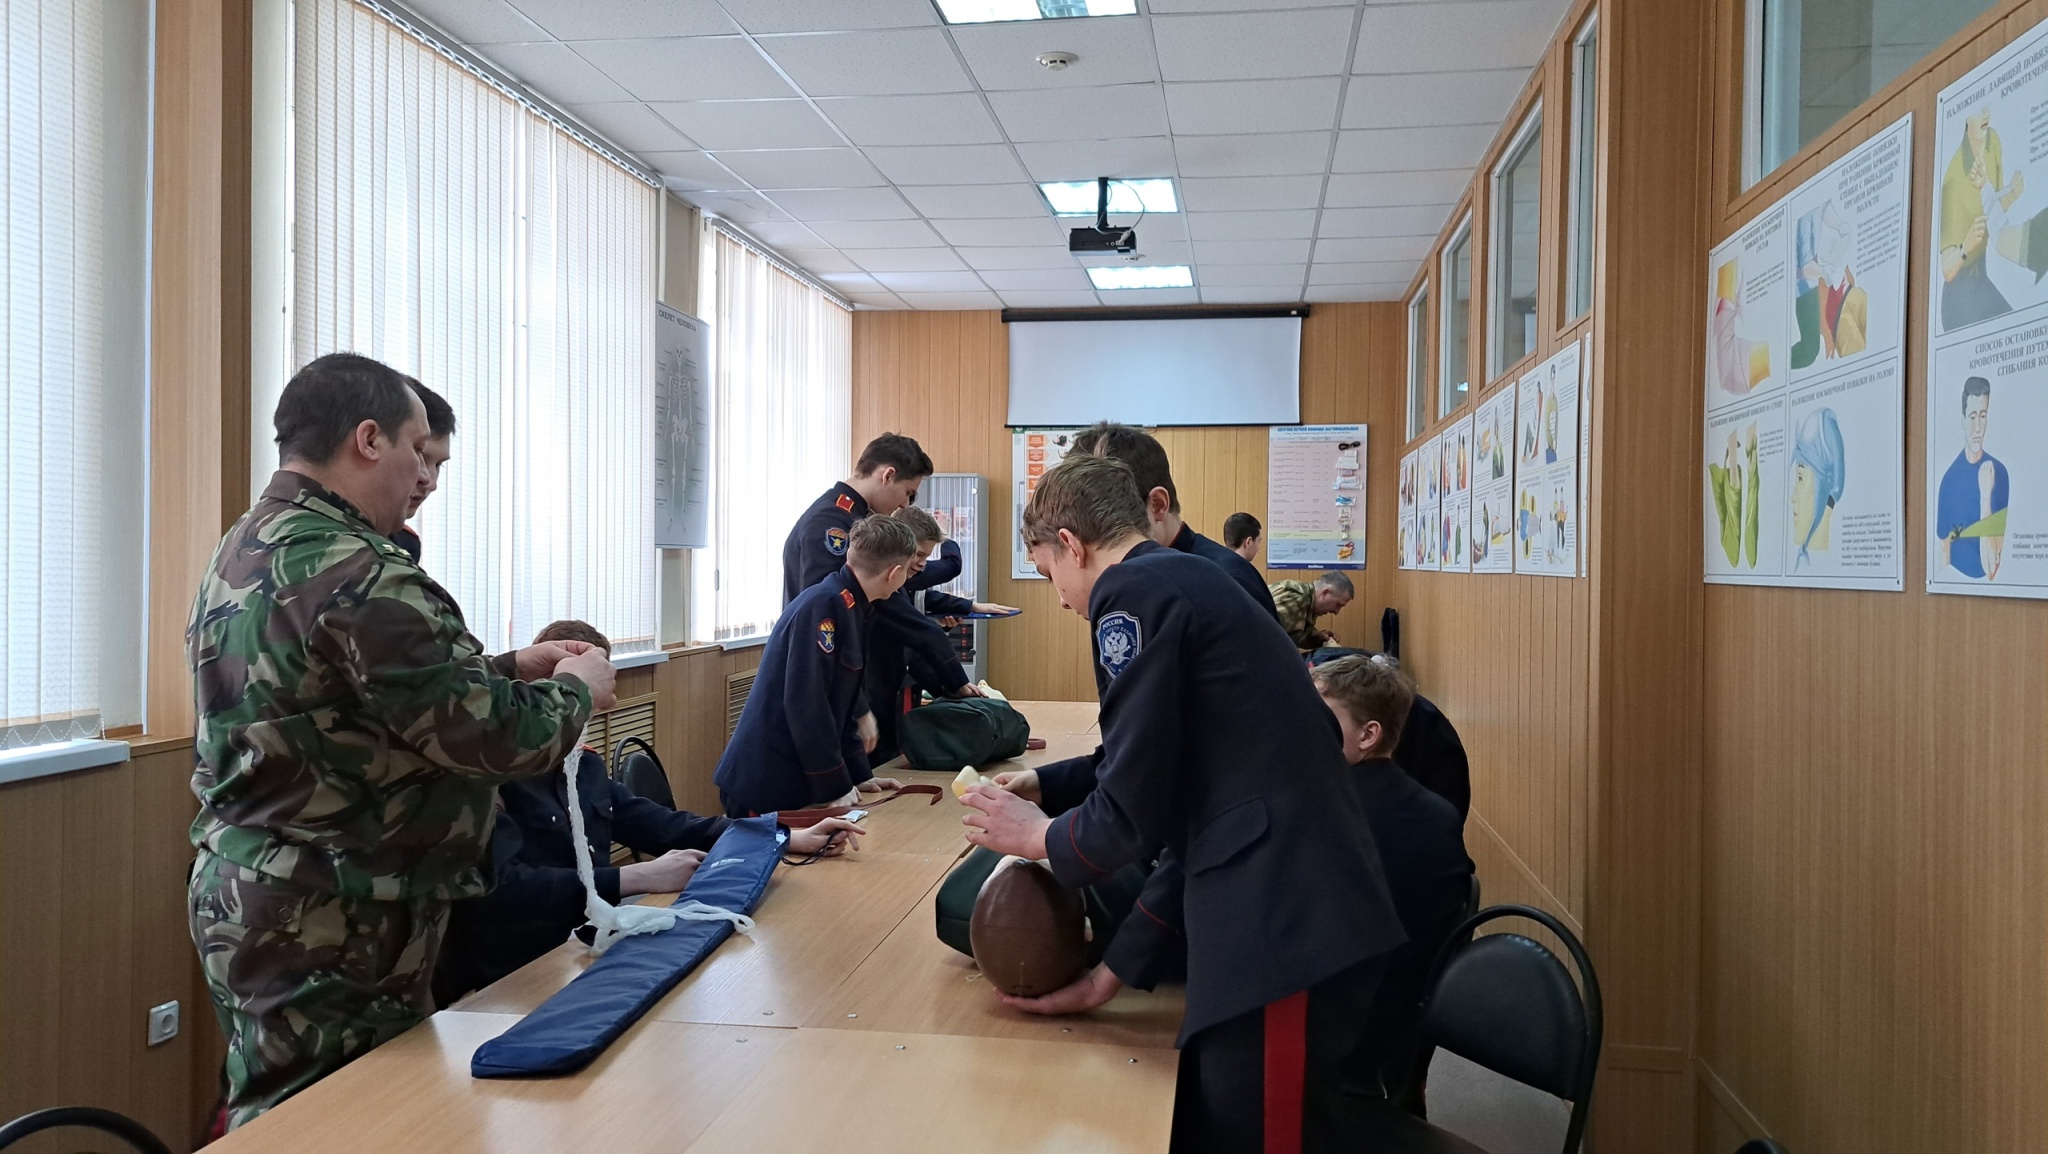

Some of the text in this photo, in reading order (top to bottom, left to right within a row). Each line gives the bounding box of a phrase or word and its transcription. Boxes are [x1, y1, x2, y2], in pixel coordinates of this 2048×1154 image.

[1975, 338, 2003, 354] СПОСОБ
[1969, 346, 2024, 370] КРОВОТЕЧЕНИЯ
[1997, 358, 2036, 376] СГИБАНИЯ
[1102, 618, 1123, 630] РОССИЯ
